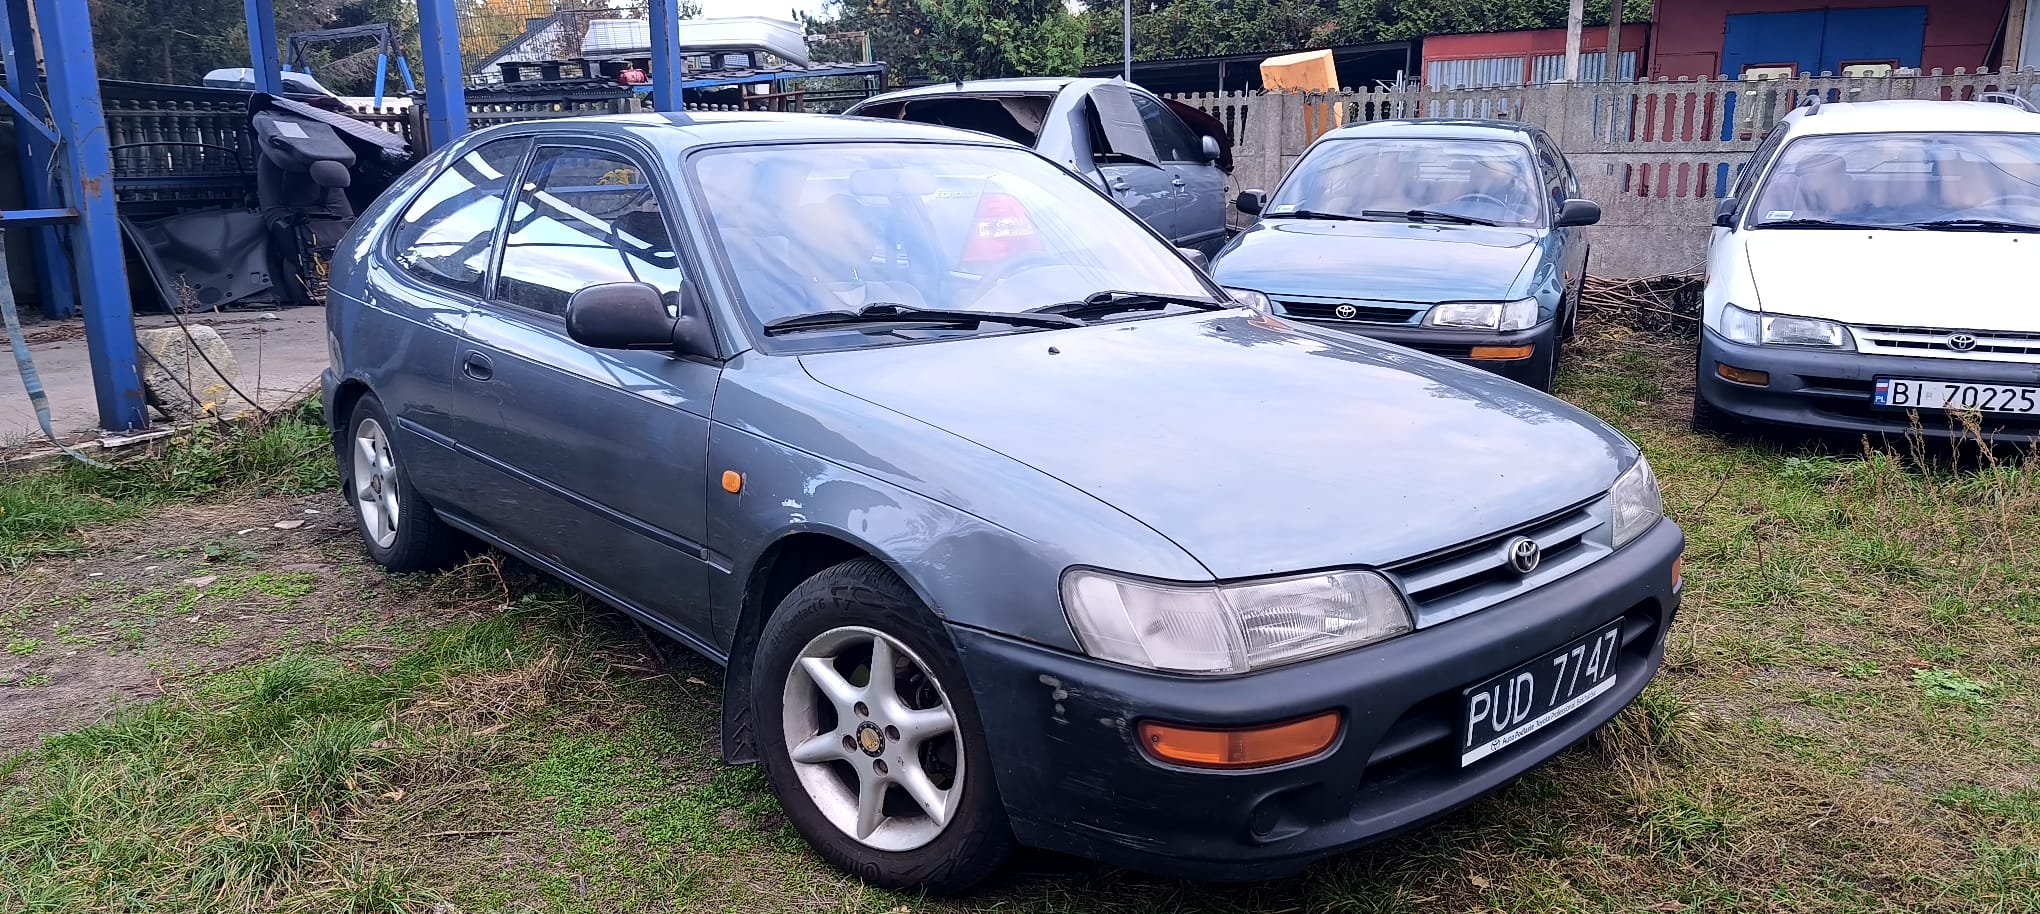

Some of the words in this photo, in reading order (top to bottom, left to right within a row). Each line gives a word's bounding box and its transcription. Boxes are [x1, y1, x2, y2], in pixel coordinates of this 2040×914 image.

[1875, 395, 1886, 403] PL
[1892, 382, 1923, 406] BI
[1944, 384, 2037, 413] 70225
[1466, 672, 1535, 747] PUD
[1549, 628, 1618, 707] 7747
